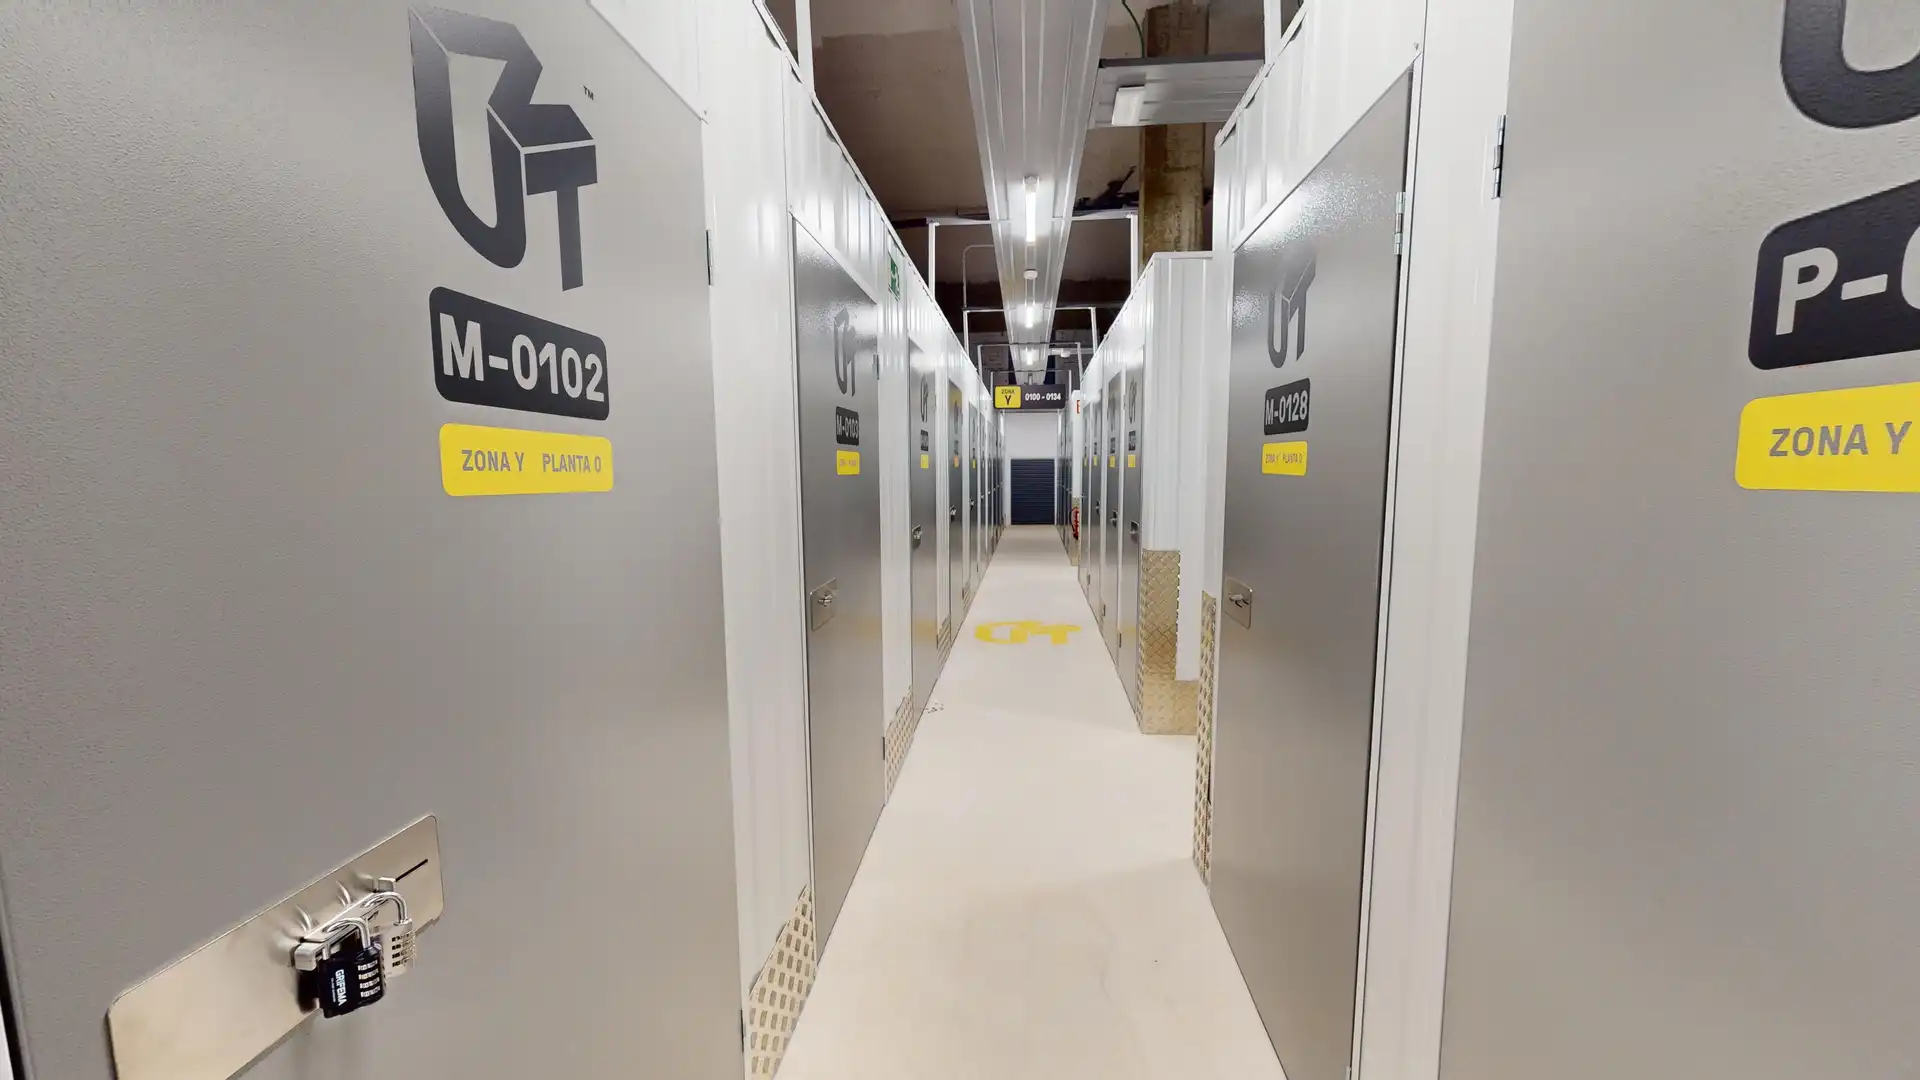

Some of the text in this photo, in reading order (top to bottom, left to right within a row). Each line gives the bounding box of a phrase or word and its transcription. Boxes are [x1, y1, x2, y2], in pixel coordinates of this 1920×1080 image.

[439, 313, 605, 402] M-0102
[1005, 395, 1011, 404] Y
[1046, 393, 1061, 401] 0134
[1265, 390, 1308, 425] M-0128
[1769, 421, 1912, 457] ZONA Y
[461, 449, 511, 472] ZONA
[514, 451, 525, 472] Y
[542, 453, 591, 473] PLANTA
[335, 969, 347, 1006] GRIFEMA
